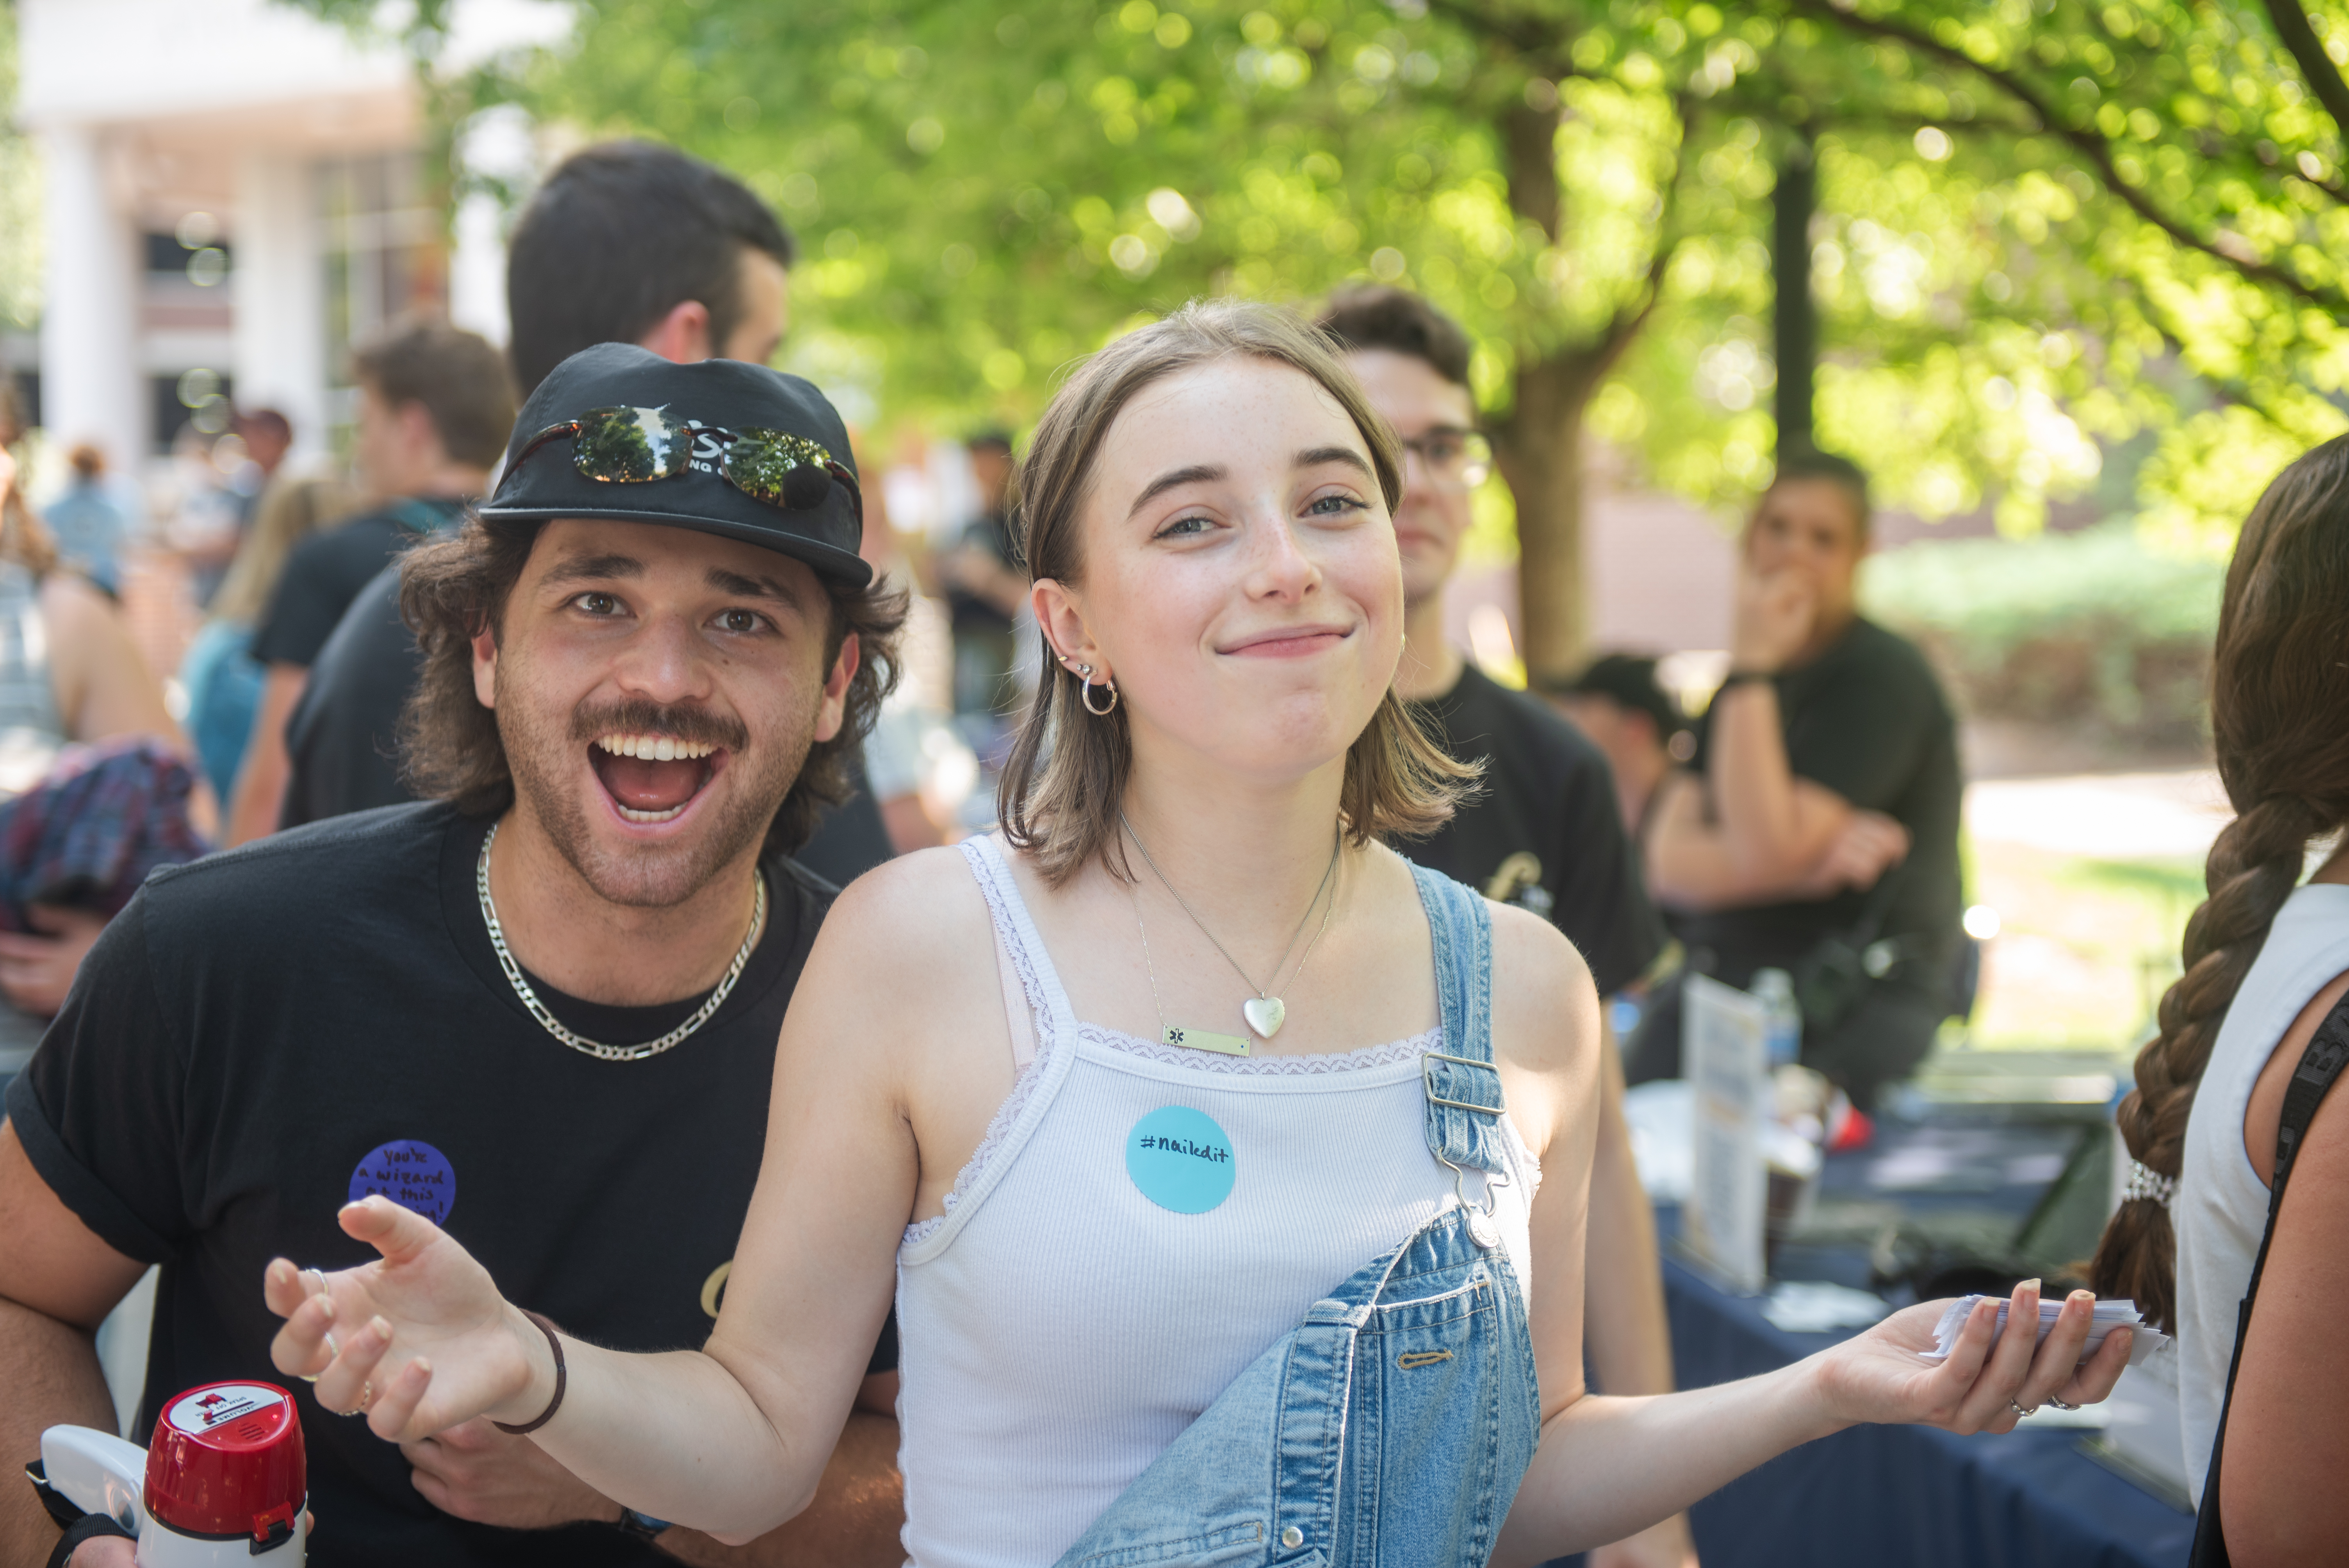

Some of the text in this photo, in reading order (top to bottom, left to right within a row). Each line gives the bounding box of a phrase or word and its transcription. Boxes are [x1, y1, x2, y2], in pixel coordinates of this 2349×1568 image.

[1140, 1134, 1229, 1163] #nailedit
[358, 1167, 443, 1185] a wizard
[399, 1187, 433, 1201] this
